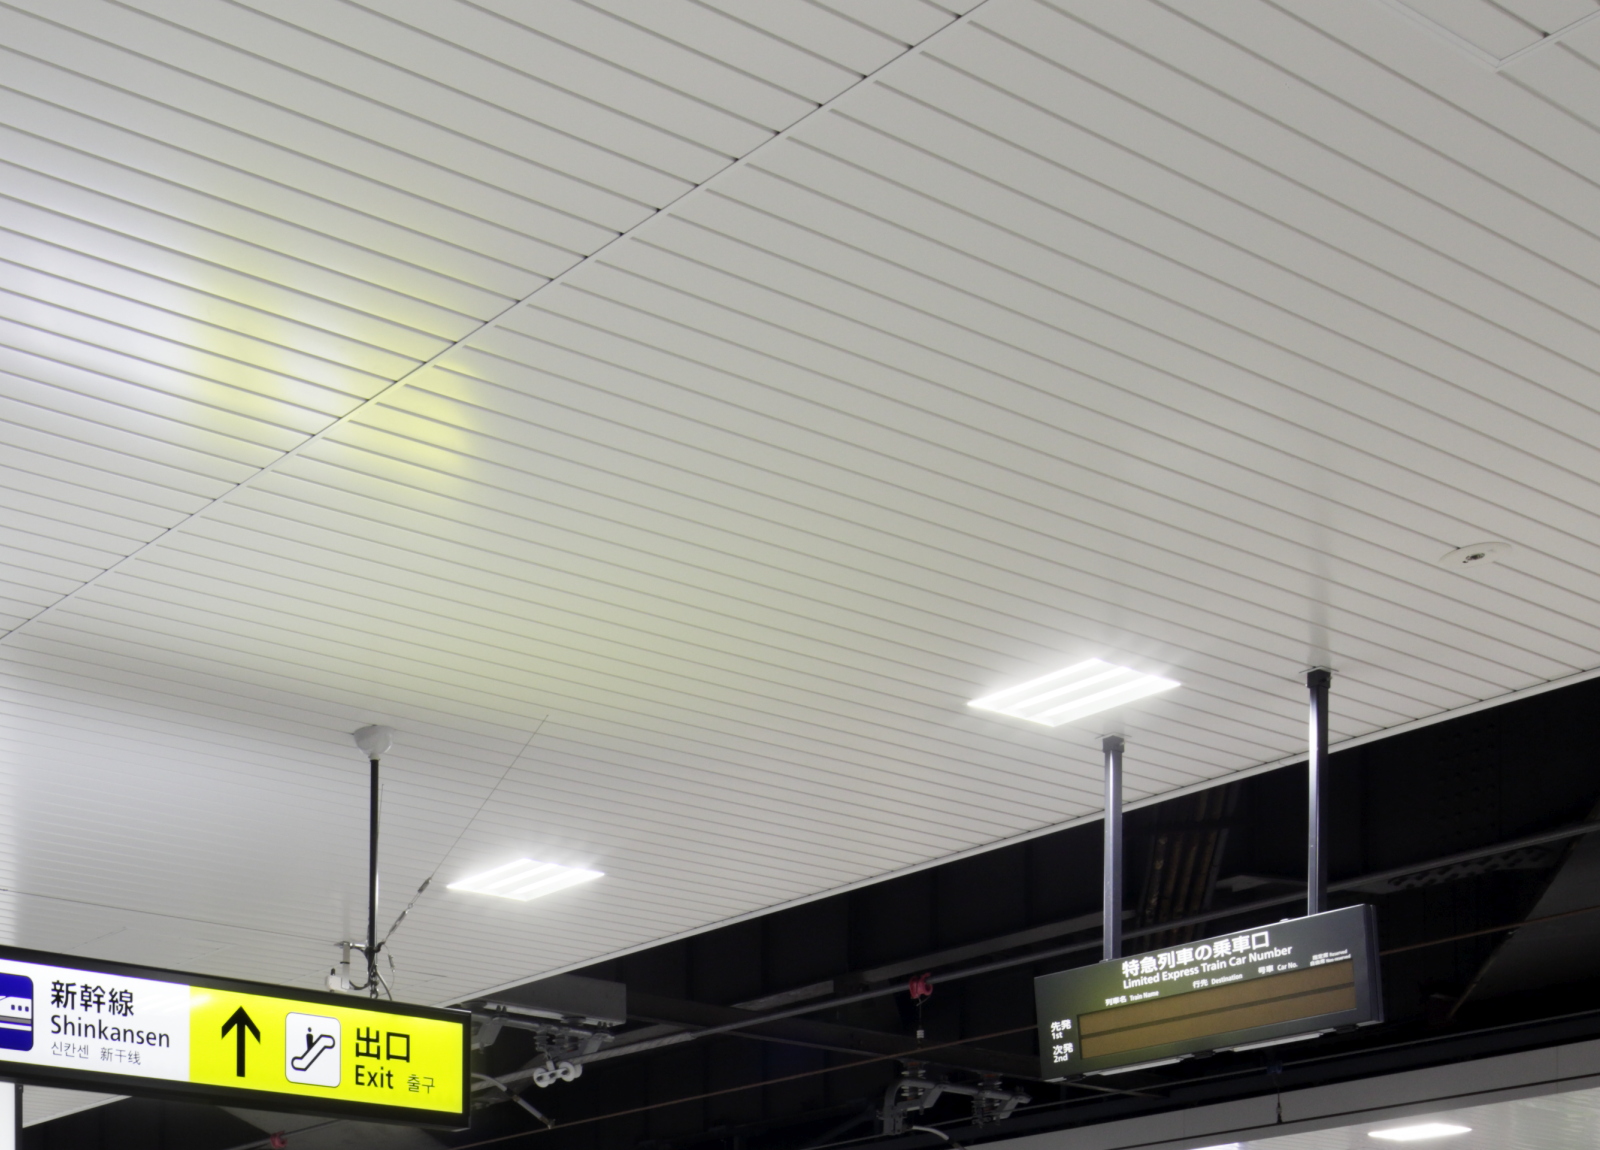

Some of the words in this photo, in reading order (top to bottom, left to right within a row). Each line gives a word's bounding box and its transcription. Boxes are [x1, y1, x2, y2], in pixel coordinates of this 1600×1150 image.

[1121, 931, 1271, 978] 特急列車の乗車口
[1122, 973, 1161, 989] Limited
[1161, 966, 1200, 982] Express
[1201, 960, 1227, 973] Train
[1229, 956, 1246, 969] Car
[1248, 945, 1293, 964] Number
[1258, 964, 1274, 974] 号車
[1277, 963, 1287, 971] Car
[1192, 978, 1209, 989] 行先
[1211, 973, 1243, 985] Destination
[50, 980, 134, 1017] 新幹線
[1105, 996, 1127, 1006] 列車名
[1129, 992, 1143, 1001] Train
[1143, 990, 1159, 999] Name
[50, 1014, 170, 1048] Shinkansen
[1050, 1019, 1072, 1032] 先発
[1051, 1031, 1063, 1039] 1st
[50, 1041, 90, 1060] 신칸센
[100, 1046, 142, 1066] 新干线
[355, 1026, 410, 1063] 出口
[1052, 1042, 1074, 1055] 次発
[1053, 1053, 1069, 1063] 2nd
[355, 1064, 394, 1089] Exit
[406, 1073, 436, 1094] 출구
